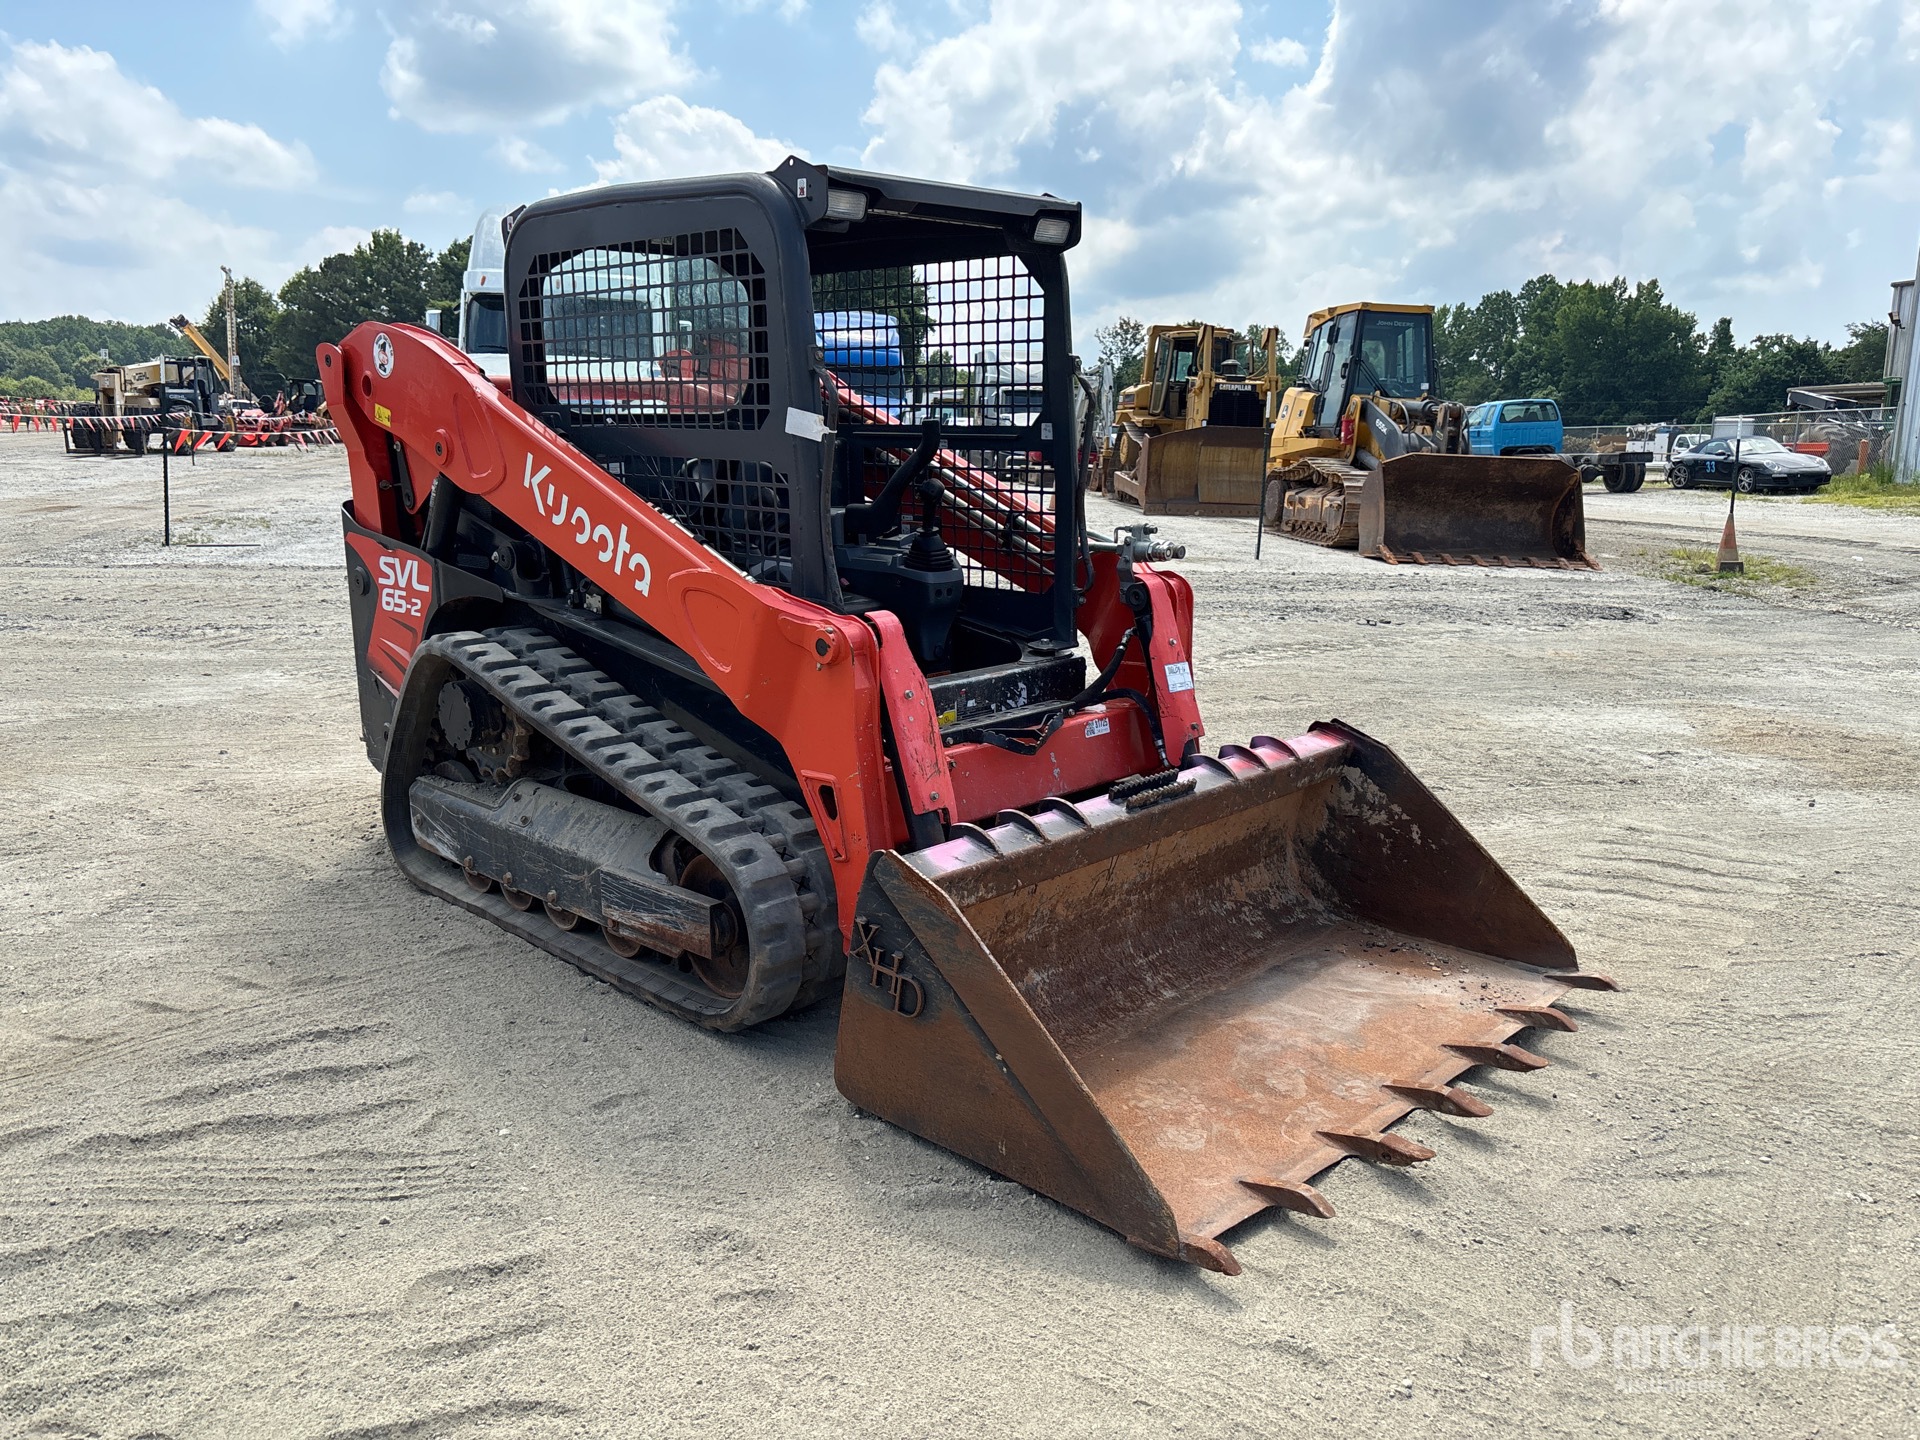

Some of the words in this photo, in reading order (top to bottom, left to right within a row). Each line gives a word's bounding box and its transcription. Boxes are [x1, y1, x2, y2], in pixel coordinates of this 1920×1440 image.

[1219, 383, 1252, 391] CATERPILLAR
[1705, 461, 1716, 473] 33
[523, 451, 651, 598] Kubota
[378, 555, 430, 592] SVL
[381, 587, 422, 617] 65-2
[850, 915, 926, 1018] XHD
